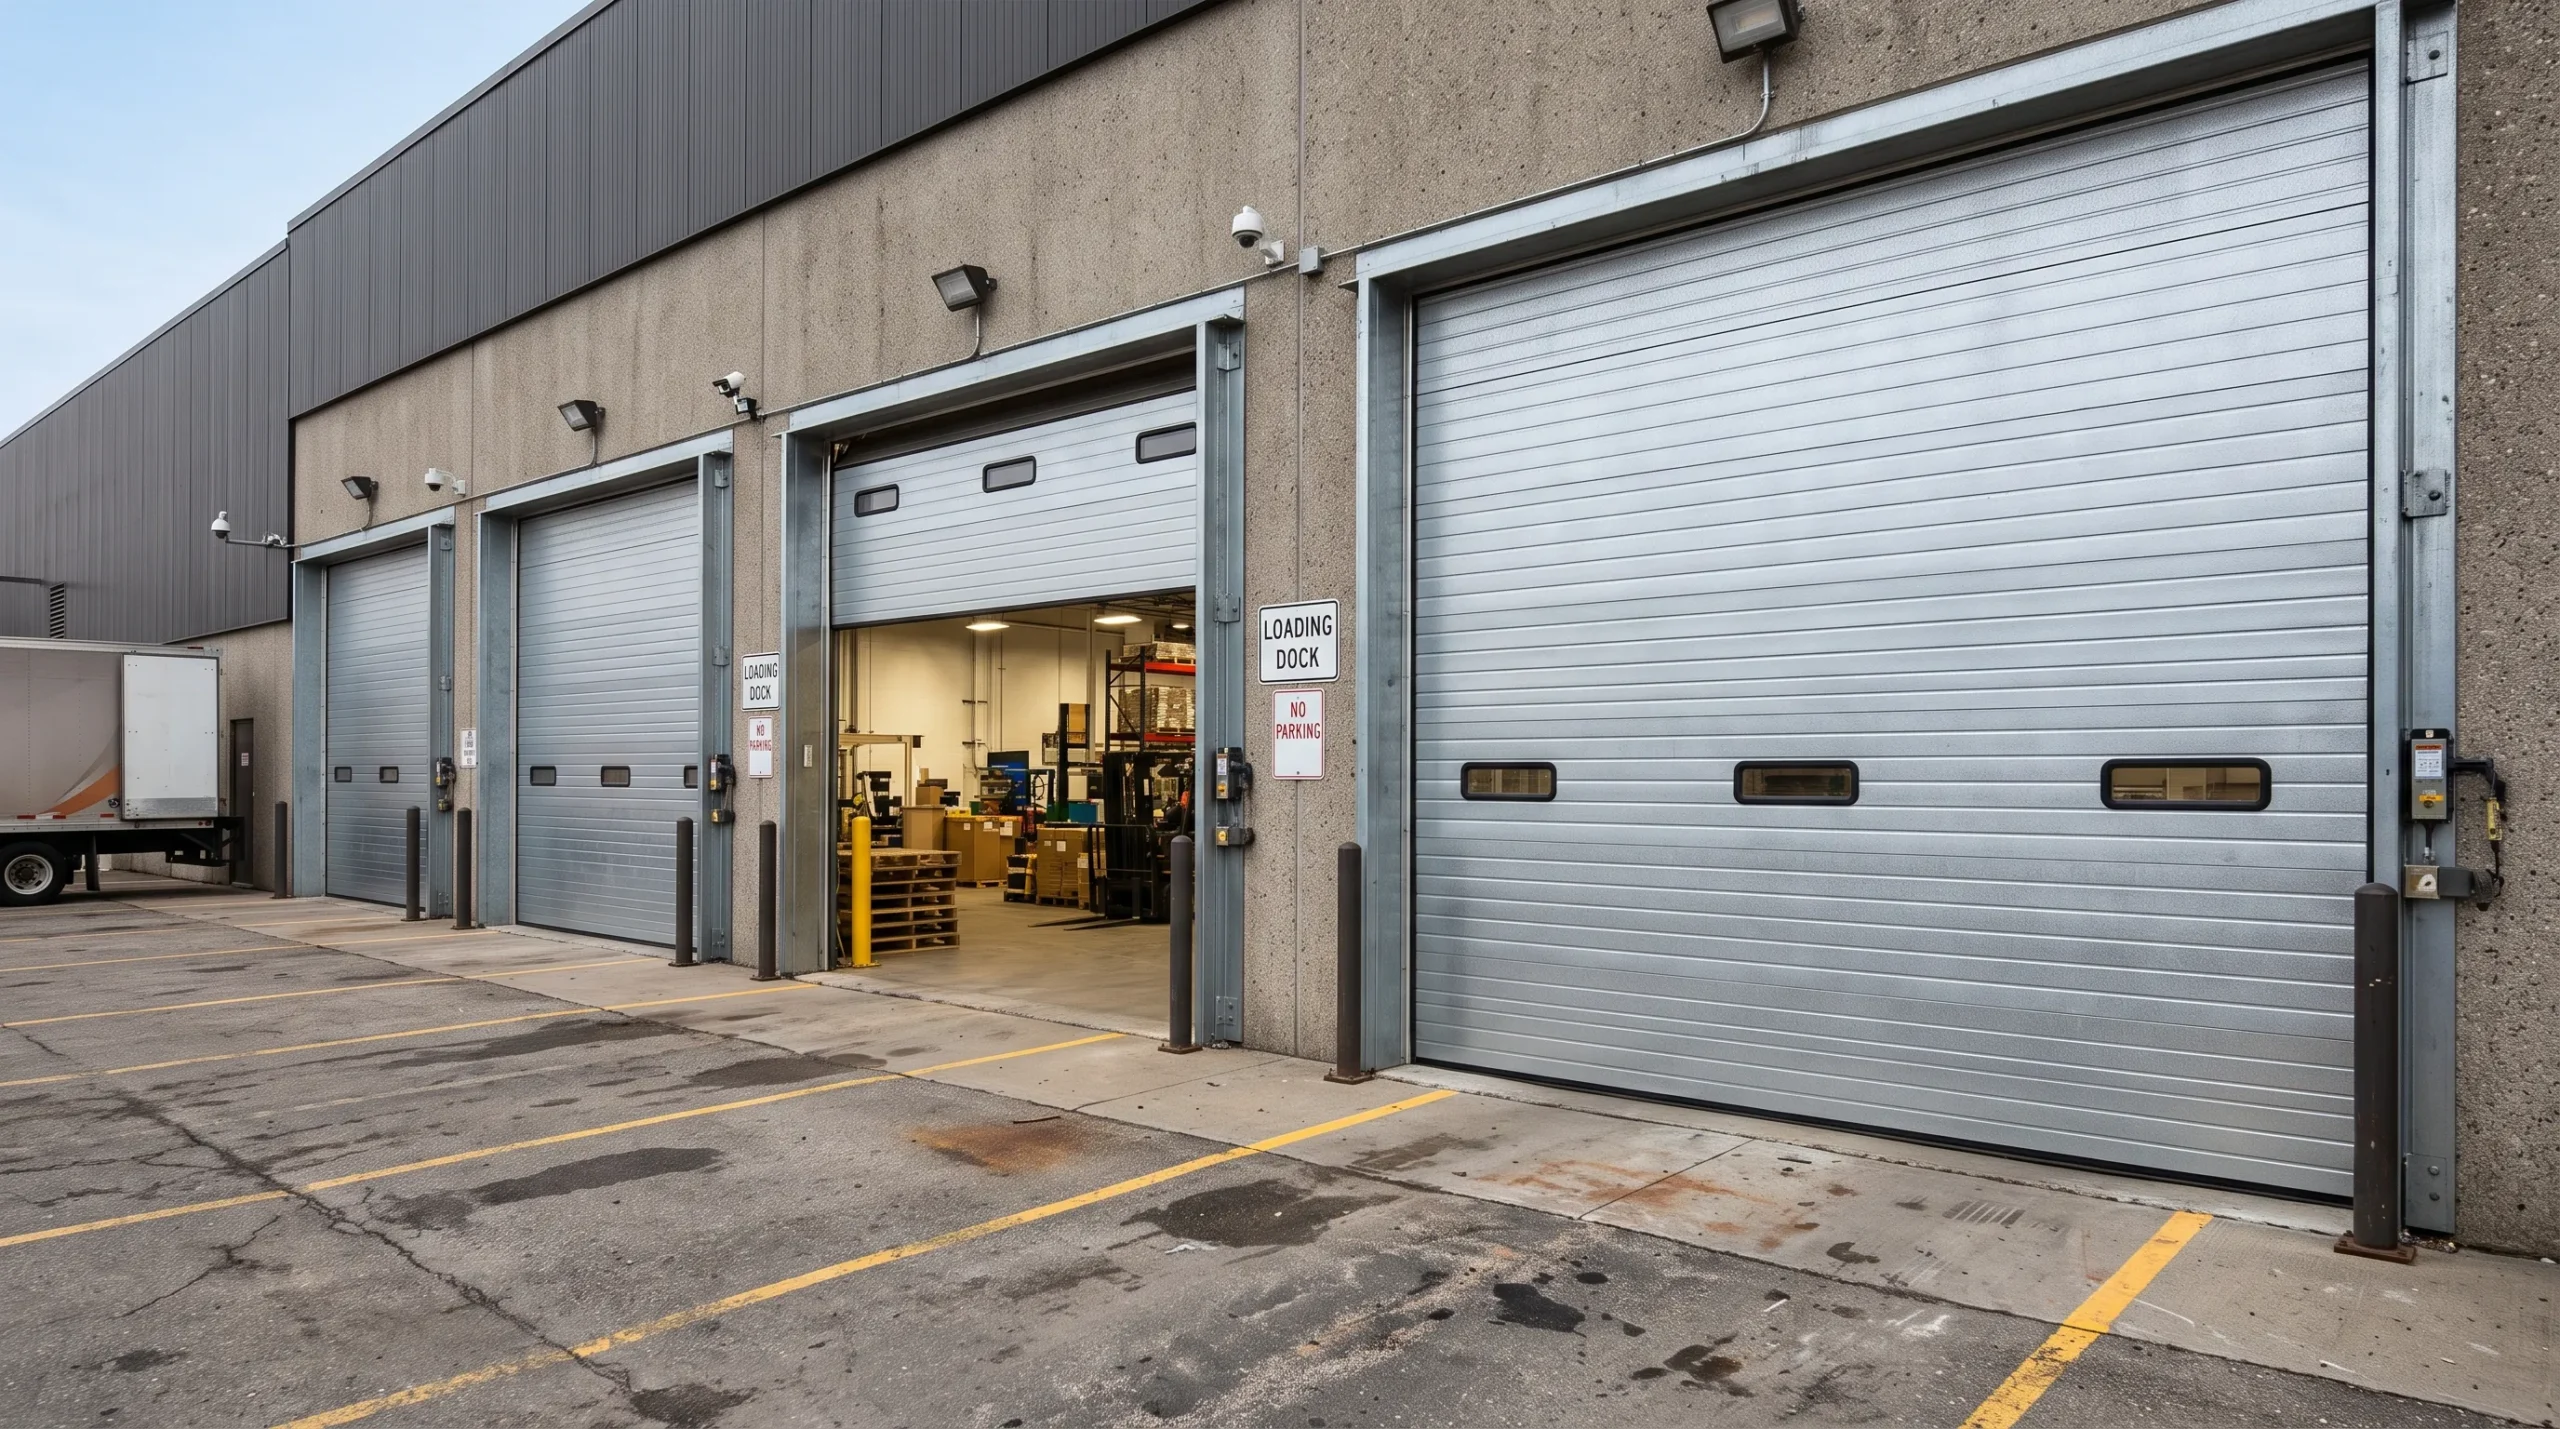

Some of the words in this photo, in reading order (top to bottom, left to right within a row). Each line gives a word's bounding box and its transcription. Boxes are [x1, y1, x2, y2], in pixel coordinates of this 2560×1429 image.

[1264, 614, 1332, 640] LOADING
[1276, 646, 1320, 670] DOCK
[750, 685, 772, 701] DOCK
[1290, 701, 1306, 718] NO
[1276, 722, 1321, 740] PARKING
